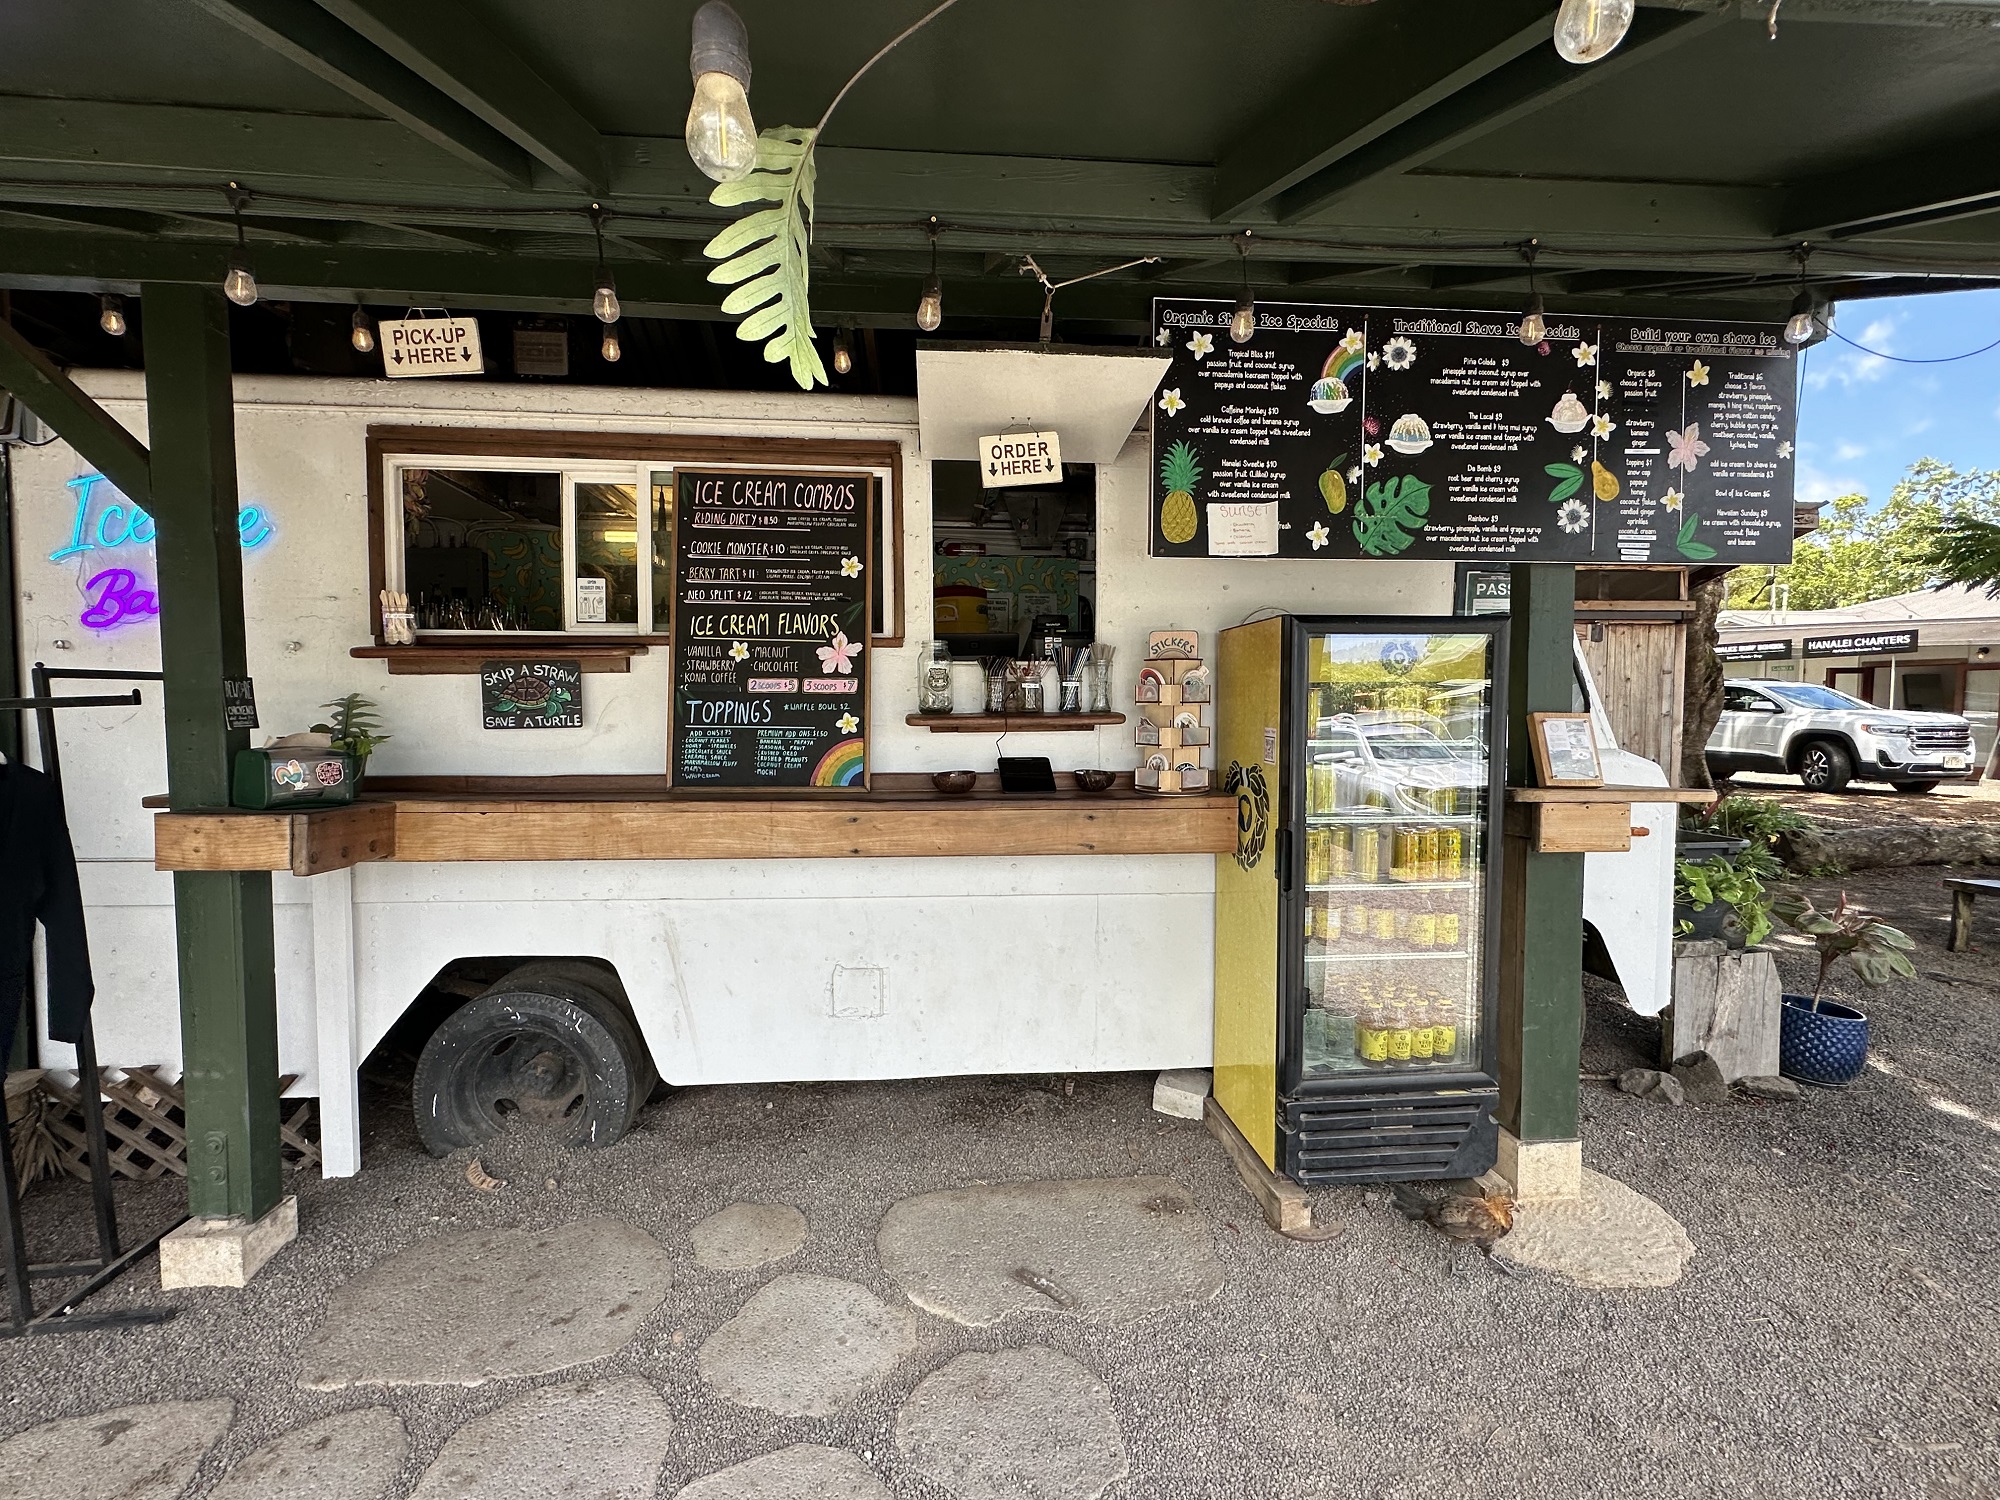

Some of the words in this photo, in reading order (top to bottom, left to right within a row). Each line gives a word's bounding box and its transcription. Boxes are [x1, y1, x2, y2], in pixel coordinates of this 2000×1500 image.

[1163, 310, 1213, 328] Organic
[1260, 314, 1282, 327] Ice
[1287, 315, 1338, 332] Specials
[1393, 319, 1461, 333] Traditional
[1466, 321, 1501, 335] Shave
[1545, 325, 1580, 338] ecials
[393, 328, 466, 345] PICK-UP
[1631, 328, 1661, 342] Build
[1665, 332, 1691, 345] your
[1696, 334, 1718, 343] own
[1723, 332, 1756, 344] shave
[1760, 332, 1776, 345] ice
[407, 347, 457, 364] HERE
[1228, 349, 1249, 358] Tropical
[1251, 350, 1263, 358] Bliss
[1265, 350, 1275, 358] $11
[1478, 358, 1496, 366] Colada
[1728, 372, 1755, 380] Traditional
[1645, 379, 1662, 388] flavors
[1749, 383, 1766, 391] flavors
[1645, 390, 1656, 398] fruit
[1221, 405, 1243, 415] Caffeine
[1245, 407, 1266, 416] Monkey
[1268, 407, 1279, 415] $10
[1469, 412, 1478, 420] The
[1480, 412, 1493, 420] Local
[1495, 413, 1502, 421] $9
[1626, 420, 1654, 428] strawberry
[1632, 440, 1647, 448] ginger
[992, 442, 1048, 459] ORDER
[1001, 459, 1042, 475] HERE
[1243, 460, 1265, 468] Sweetie
[1626, 459, 1644, 467] topping
[1494, 465, 1501, 473] $9
[696, 481, 723, 505] ICE
[732, 481, 786, 506] CREAM
[794, 483, 854, 510] COMBOS
[1631, 489, 1646, 497] honey
[1729, 490, 1734, 498] of
[1220, 506, 1270, 517] SUNSET
[1740, 509, 1759, 518] Sunday
[695, 512, 726, 524] RIDING
[730, 513, 757, 525] DIRTY
[1468, 515, 1489, 523] Rainbow
[1491, 515, 1498, 523] $9
[1627, 518, 1648, 526] sprinkles
[691, 541, 721, 554] COOKIE
[727, 542, 769, 555] MONSTER
[770, 544, 785, 554] $10
[689, 567, 715, 579] BERRY
[719, 568, 740, 580] TART
[688, 590, 704, 600] NEO
[710, 590, 733, 600] SPLIT
[737, 591, 752, 600] $12
[691, 615, 713, 635] ICE
[720, 614, 768, 635] CREAM
[778, 612, 839, 638] FLAVORS
[1151, 637, 1194, 655] STICKERS
[1808, 638, 1853, 650] HANALEI
[1854, 634, 1910, 646] CHARTERS
[687, 646, 721, 657] VANILLA
[754, 646, 790, 658] MACNUT
[686, 660, 736, 671] STRAWBERRY
[754, 661, 798, 672] CHOCOLATE
[483, 668, 514, 685] SKIP
[521, 665, 529, 675] A
[533, 665, 578, 682] STRAW
[685, 672, 706, 683] KONA
[711, 673, 736, 683] COFFEE
[751, 680, 757, 690] 2
[806, 681, 812, 690] 3
[813, 683, 837, 691] SCOOPS
[686, 700, 771, 724] TOPPINGS
[790, 702, 814, 711] WAFFLE
[486, 716, 515, 727] SAVE
[524, 717, 533, 727] A
[535, 715, 581, 726] TURTLE
